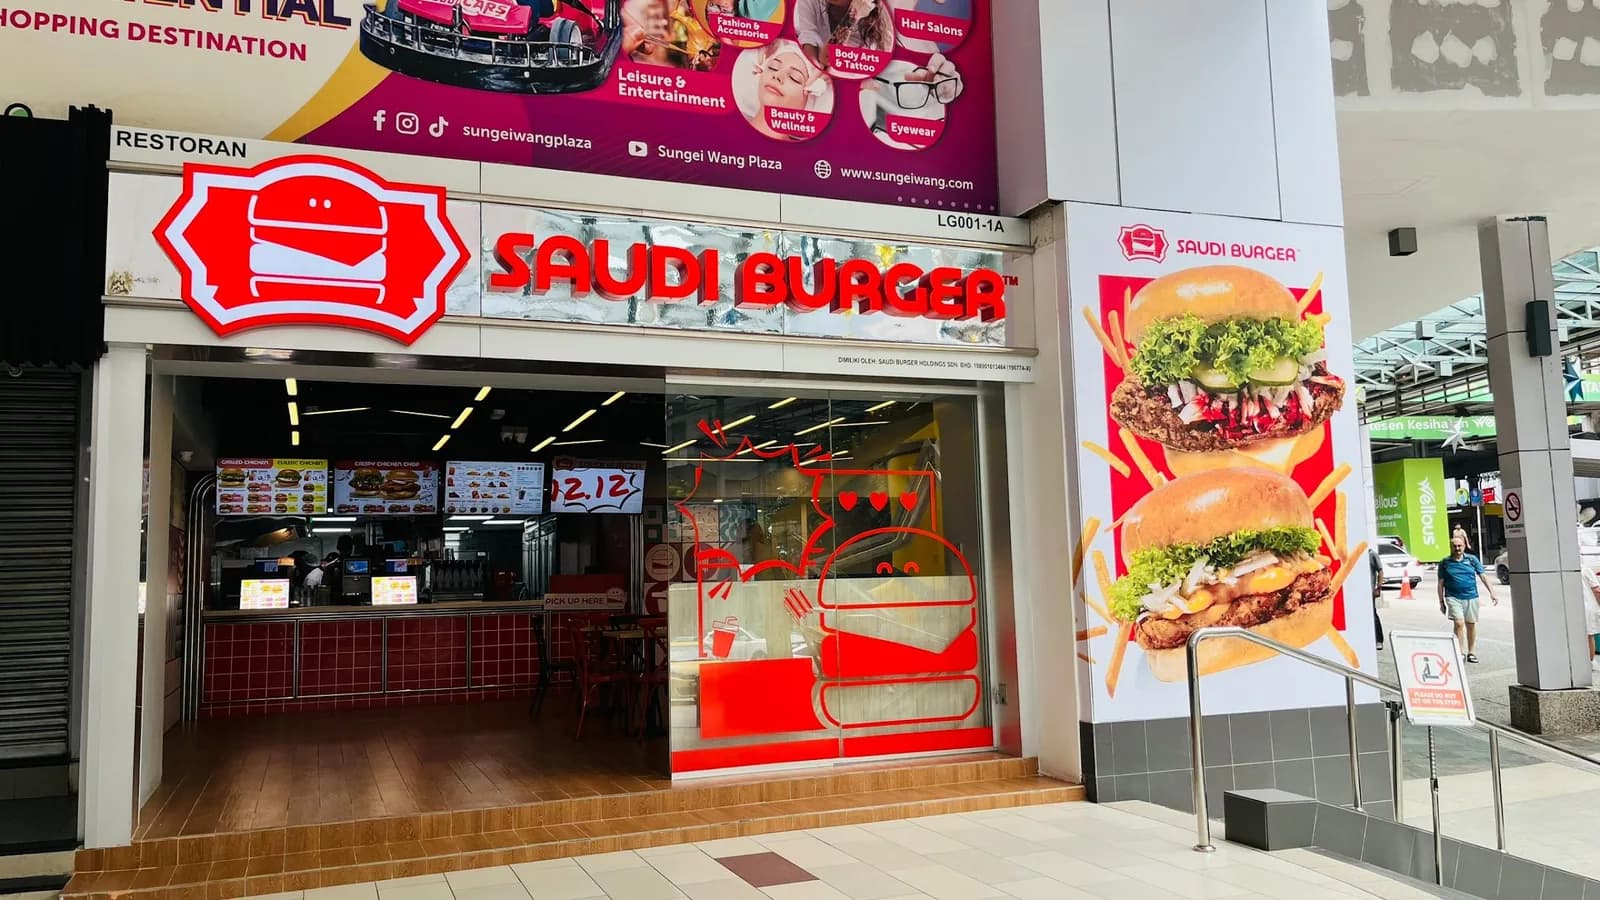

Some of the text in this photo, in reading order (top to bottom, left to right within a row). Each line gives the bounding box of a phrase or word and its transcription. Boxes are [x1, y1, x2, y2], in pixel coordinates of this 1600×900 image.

[717, 17, 752, 30] Fashion
[717, 25, 769, 39] Accessories
[901, 17, 963, 36] Hair Salons
[128, 22, 306, 61] DESTINATION
[835, 49, 879, 63] Body Arts
[835, 60, 875, 72] & Tattoo
[618, 68, 686, 88] Leisure &
[618, 83, 726, 108] Entertainment
[771, 108, 814, 122] Beauty &
[771, 119, 816, 133] Wellness
[891, 122, 936, 137] Eyewear
[116, 130, 247, 158] RESTORAN
[463, 125, 592, 149] sungeiwangplaza
[658, 145, 782, 170] Sungei Wang Plaza
[840, 167, 974, 190] www.sungeiwang.com
[938, 214, 1005, 233] LG001-1A
[1176, 239, 1297, 262] SAUDI BURGER
[488, 232, 719, 306] SAUDI
[735, 251, 1006, 323] BURGER
[1408, 418, 1469, 430] Kesihan
[545, 597, 604, 605] PICK UP HERE
